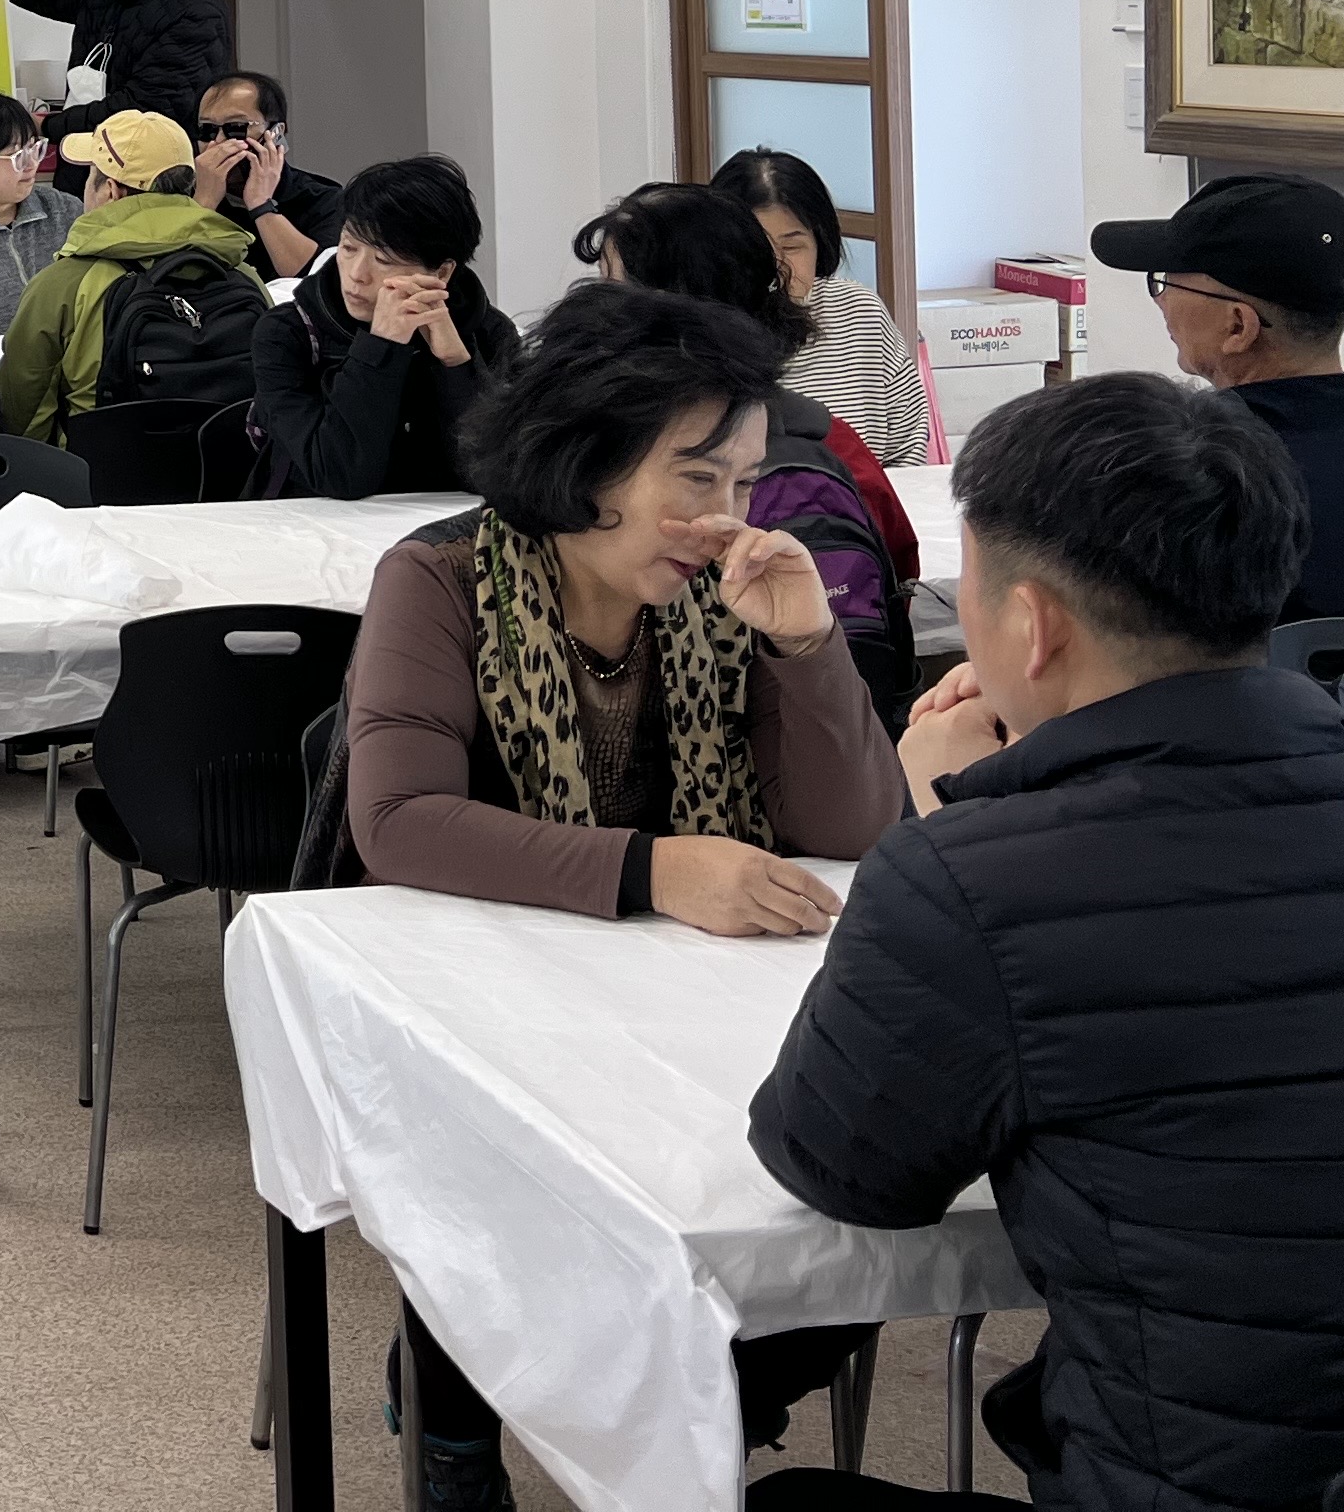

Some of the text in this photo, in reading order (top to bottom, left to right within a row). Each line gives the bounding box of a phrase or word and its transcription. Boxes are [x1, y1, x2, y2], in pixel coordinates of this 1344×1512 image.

[997, 264, 1039, 286] Moneda
[951, 326, 1021, 340] ECOHANDS
[962, 340, 1010, 353] 비누베이스
